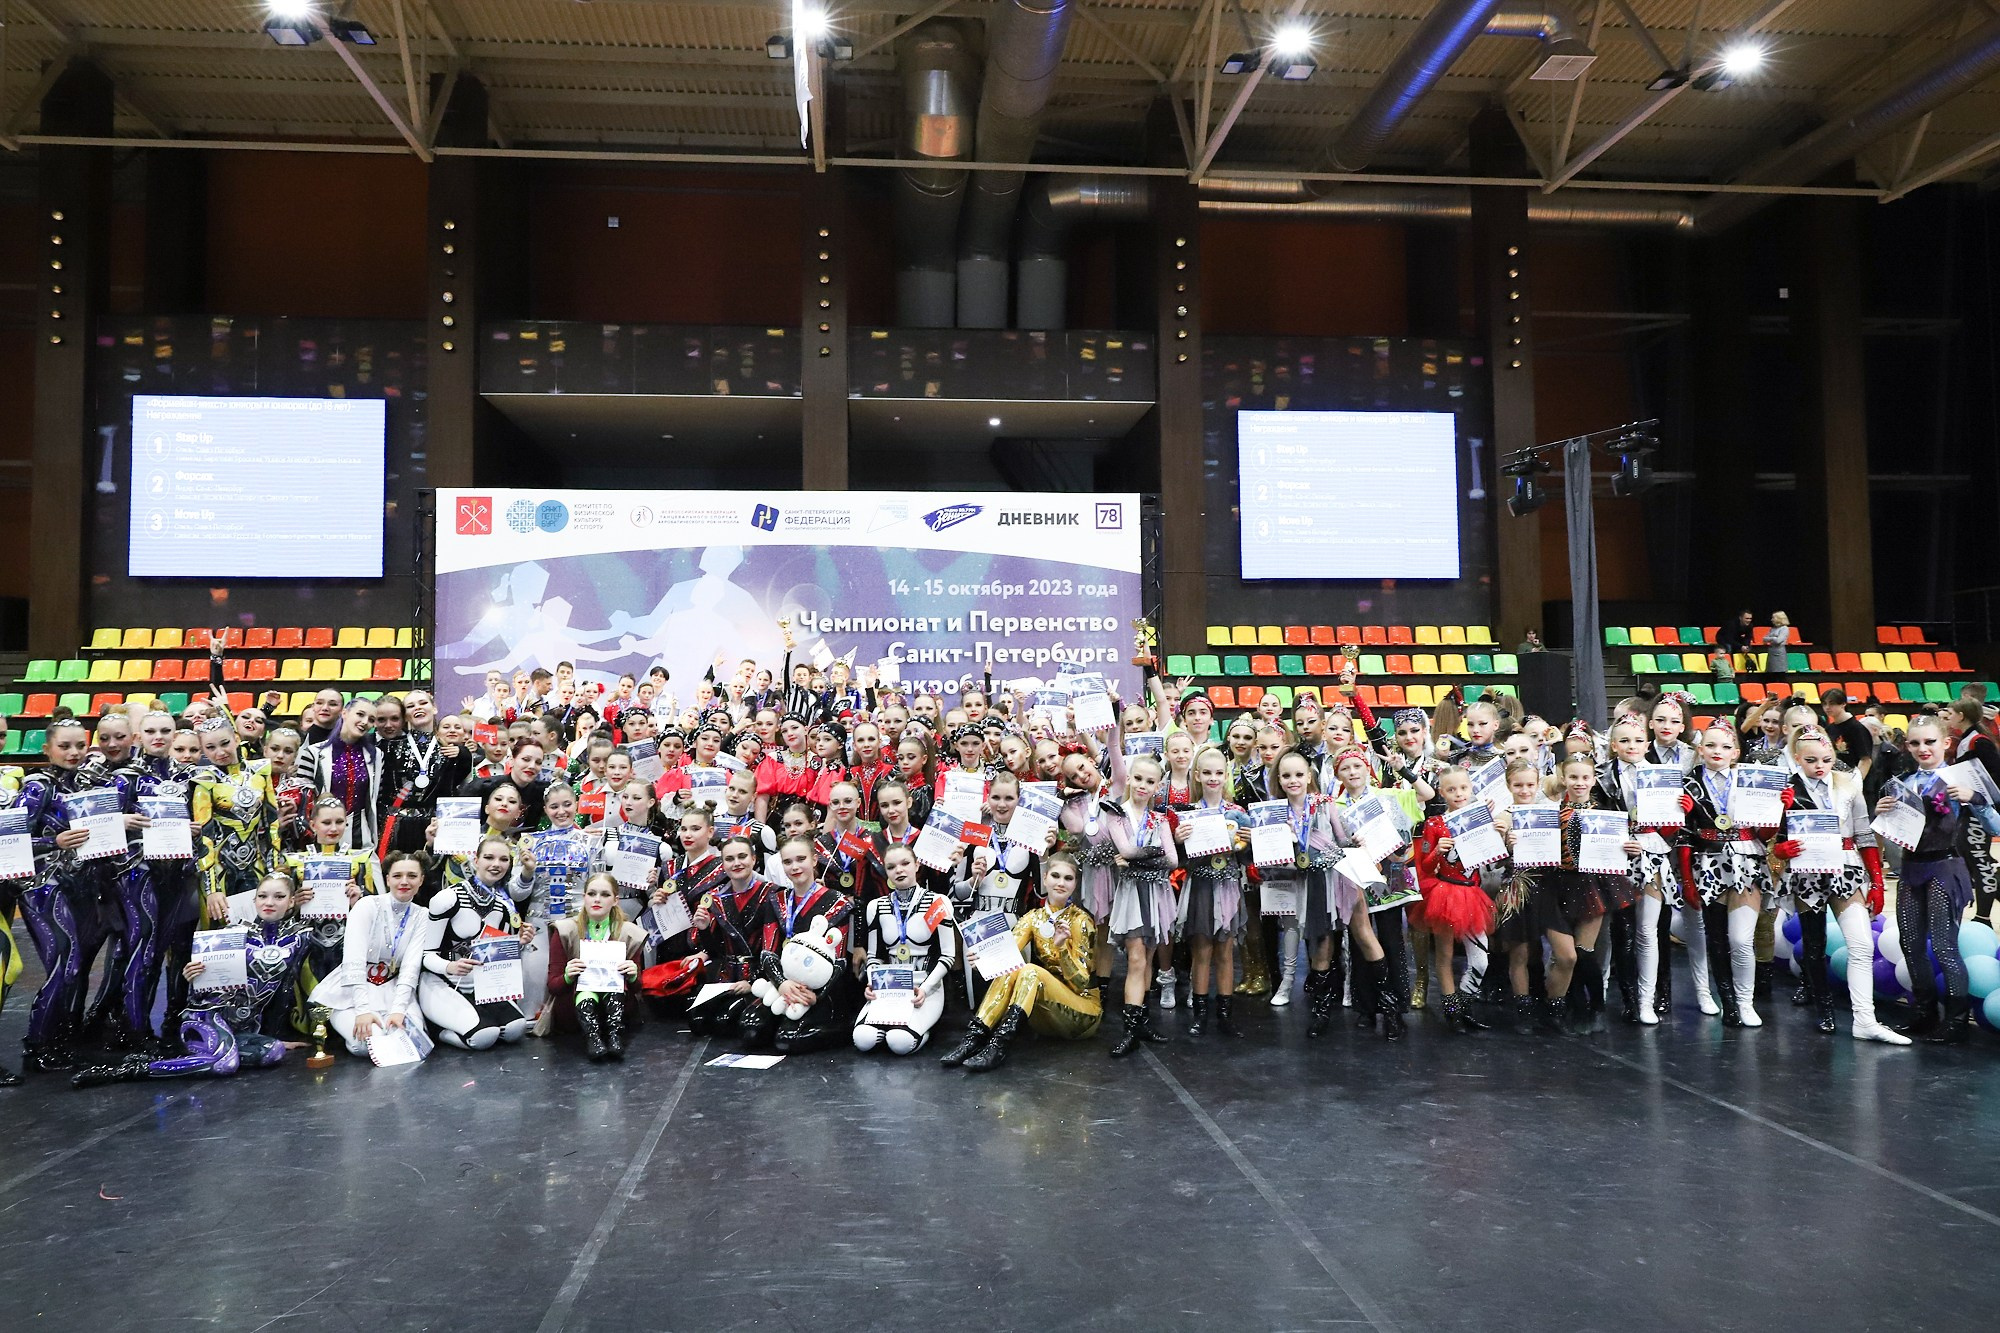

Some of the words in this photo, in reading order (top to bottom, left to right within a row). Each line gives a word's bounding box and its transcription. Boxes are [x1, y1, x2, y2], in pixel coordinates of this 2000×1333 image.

[154, 436, 163, 454] 1
[176, 432, 198, 444] Step
[200, 432, 214, 445] Up
[1257, 449, 1266, 465] 1
[152, 476, 164, 493] 2
[1257, 484, 1268, 501] 2
[151, 514, 162, 531] 3
[174, 509, 200, 520] Move
[201, 509, 215, 521] Up
[784, 516, 851, 526] ФЕДЕРАЦИЯ
[998, 512, 1079, 526] ДНЕВНИК
[1100, 509, 1118, 524] 78
[1258, 520, 1269, 537] 3
[888, 580, 910, 596] 14
[924, 580, 944, 596] 15
[948, 580, 1024, 599] октября
[1028, 580, 1072, 596] 2023
[1078, 584, 1118, 598] года
[800, 610, 941, 632] Чемпионат
[947, 616, 962, 632] и
[970, 610, 1118, 636] Первенство
[888, 641, 1118, 668] Санкт-Петербурга
[1484, 778, 1504, 796] ДИПЛОМ
[1746, 790, 1777, 798] ДИПЛОМ
[1022, 811, 1048, 824] ДИПЛОМ
[1895, 802, 1919, 818] ДИПЛОМ
[82, 816, 114, 827] ДИПЛОМ
[929, 829, 955, 845] ДИПЛОМ
[1258, 826, 1283, 835] ДИПЛОМ
[1462, 826, 1488, 842] ДИПЛОМ
[623, 853, 648, 863] ДИПЛОМ
[656, 910, 668, 932] ДИПЛОМ
[978, 936, 1005, 952] ДИПЛОМ
[202, 952, 236, 962] ДИПЛОМ
[483, 963, 512, 972] ДИПЛОМ
